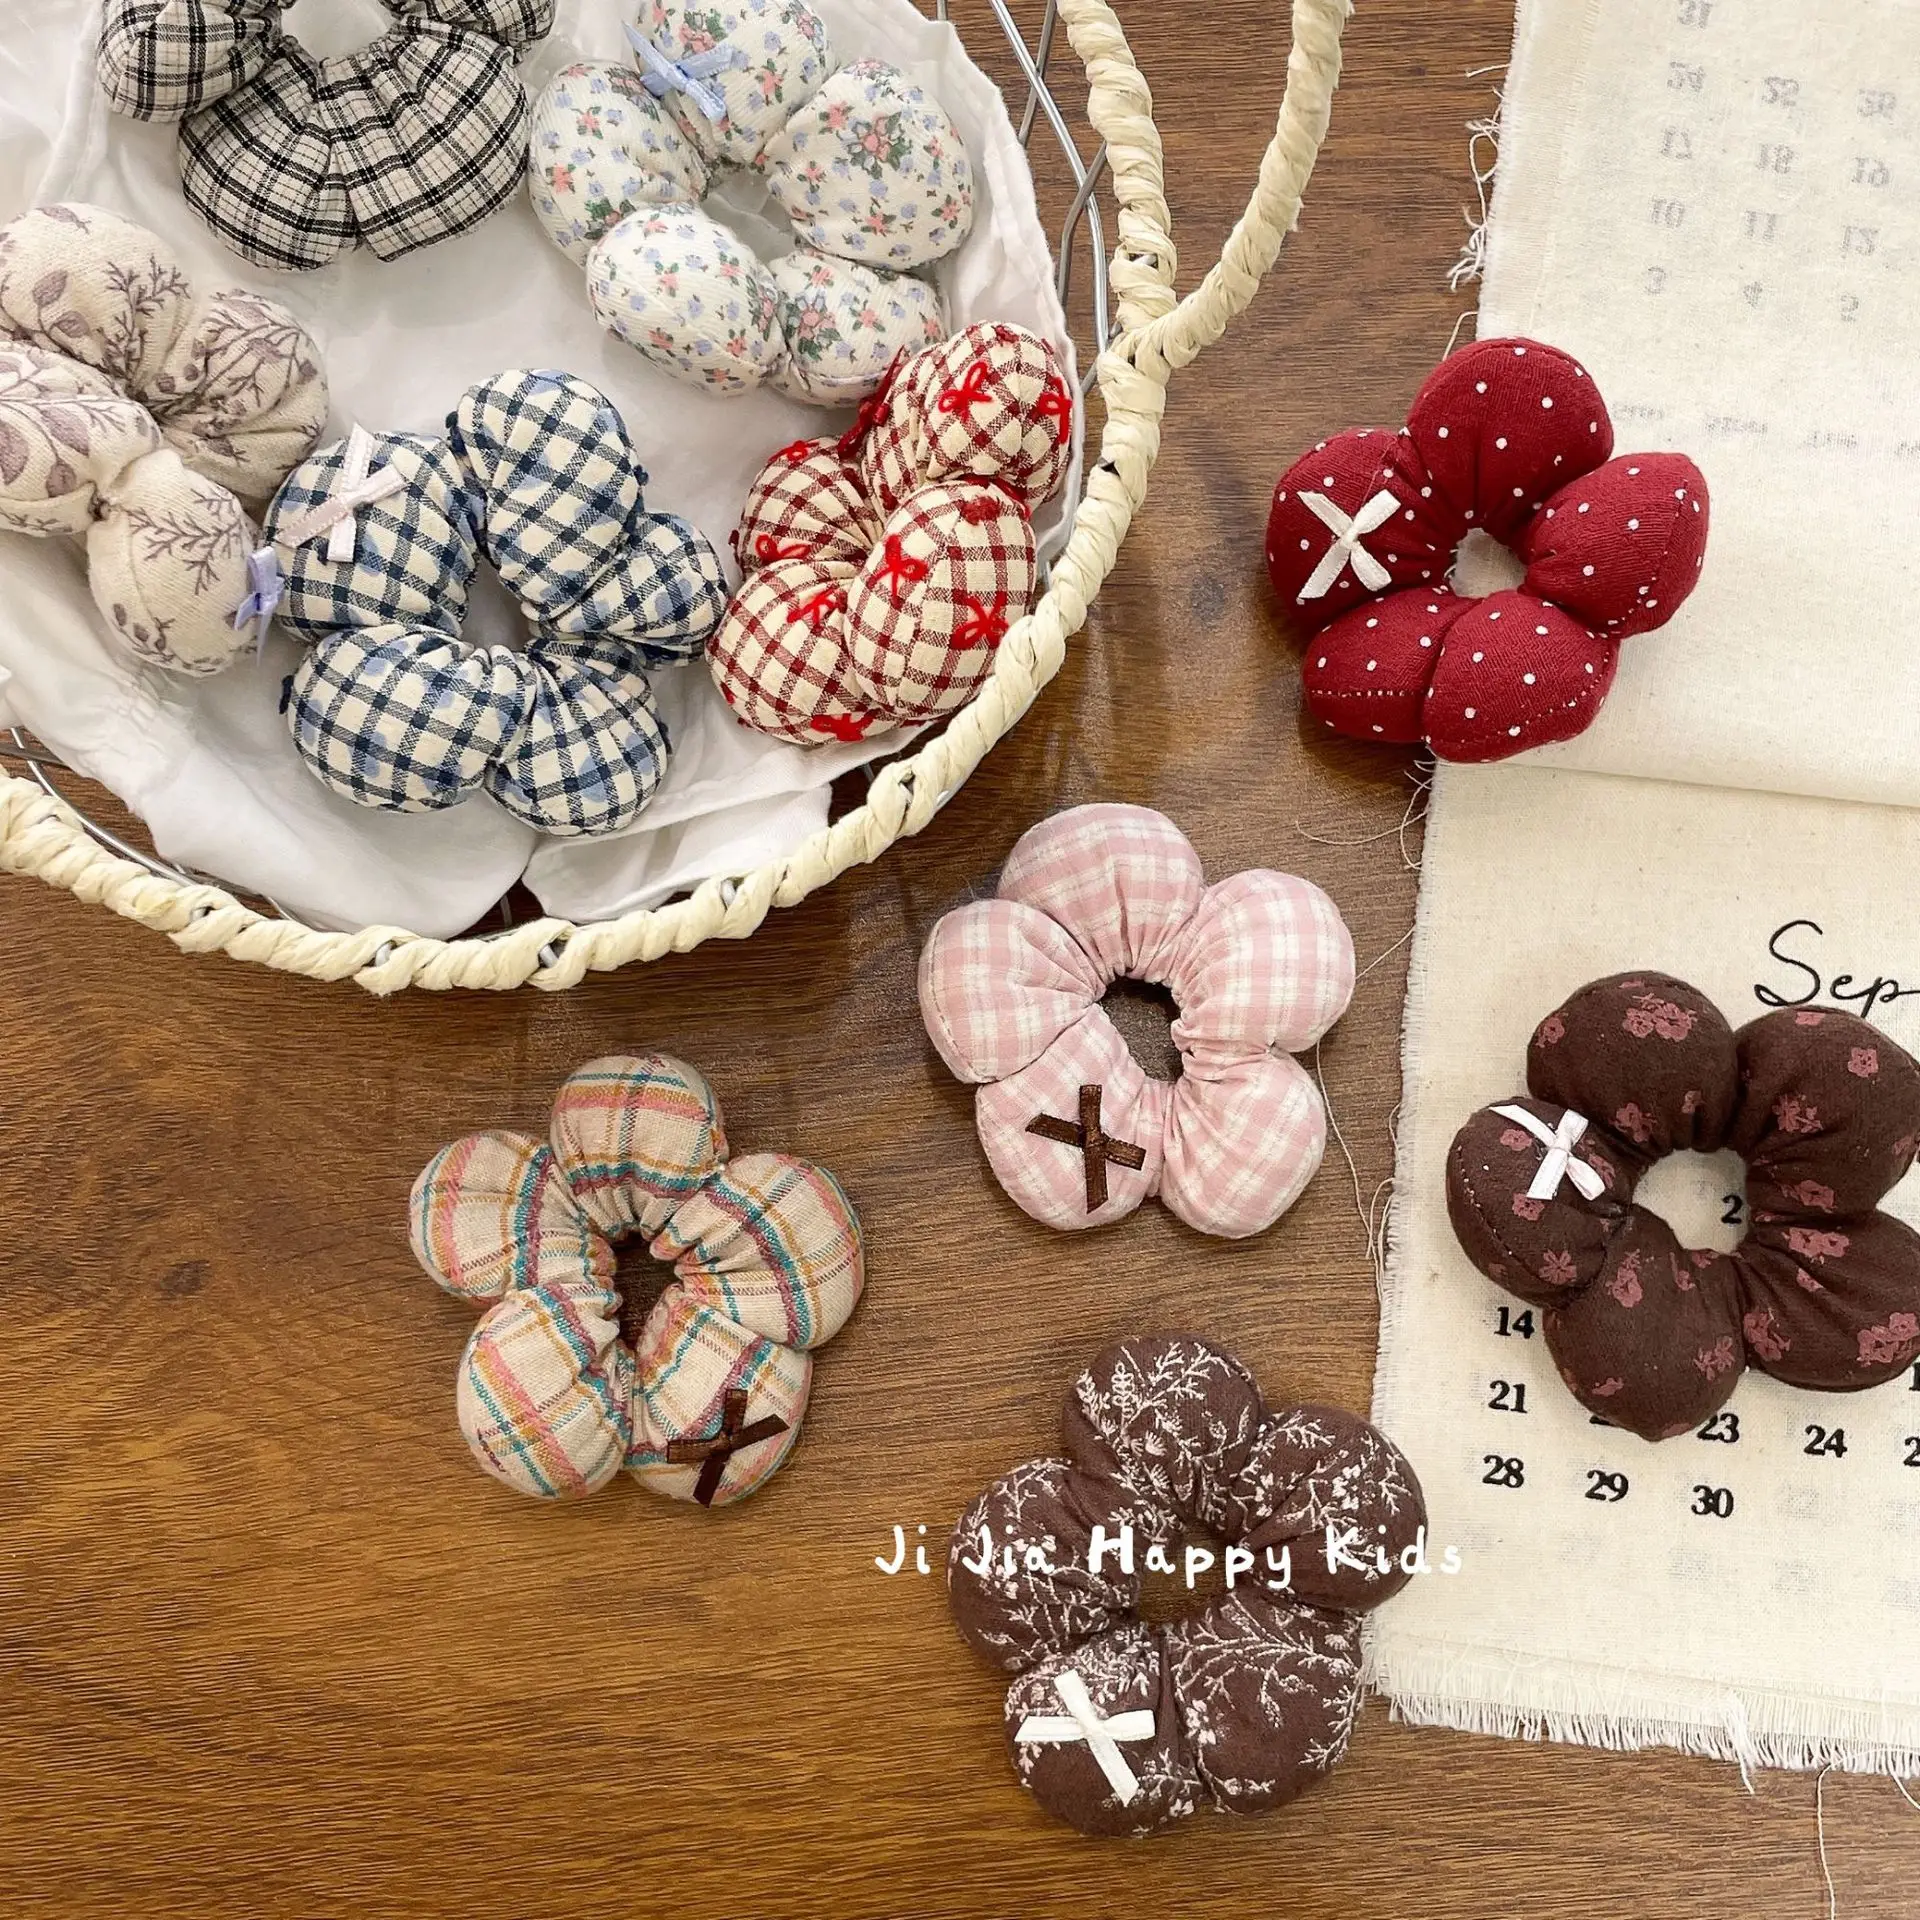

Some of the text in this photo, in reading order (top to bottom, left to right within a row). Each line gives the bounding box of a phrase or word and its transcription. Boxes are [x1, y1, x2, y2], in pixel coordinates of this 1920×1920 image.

[1720, 1195, 1742, 1224] 2
[1494, 1307, 1535, 1339] 14
[1487, 1380, 1528, 1413] 21
[1697, 1413, 1920, 1467] 23 24 2
[1482, 1455, 1734, 1518] 28 29 30
